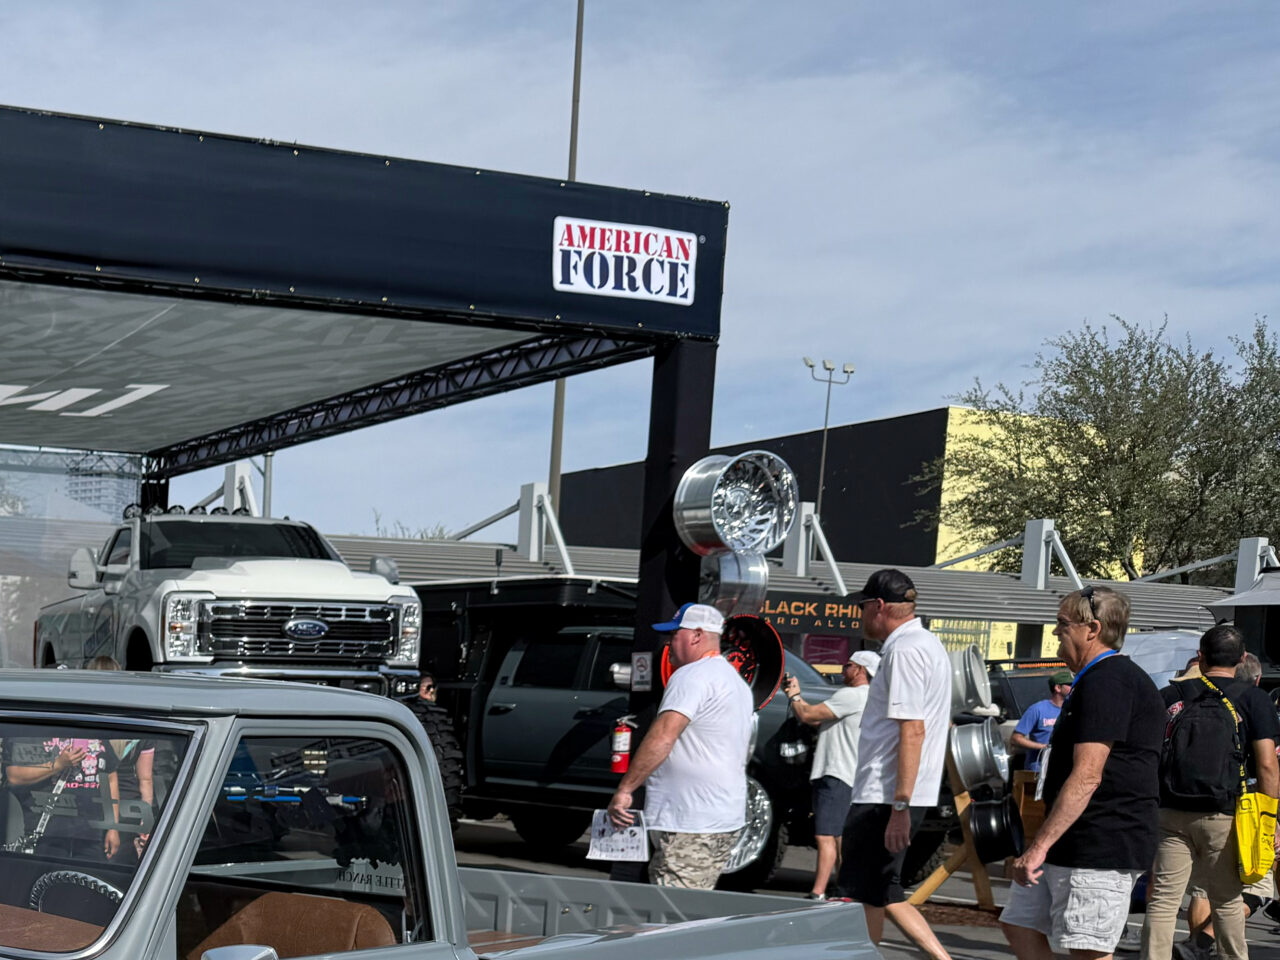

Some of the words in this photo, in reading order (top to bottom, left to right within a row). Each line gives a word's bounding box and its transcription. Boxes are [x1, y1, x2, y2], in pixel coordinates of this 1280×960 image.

[558, 223, 693, 262] AMERICAN
[559, 249, 690, 299] FORCE
[760, 600, 818, 616] LACK
[764, 617, 799, 626] ARD
[814, 620, 860, 629] ALLO
